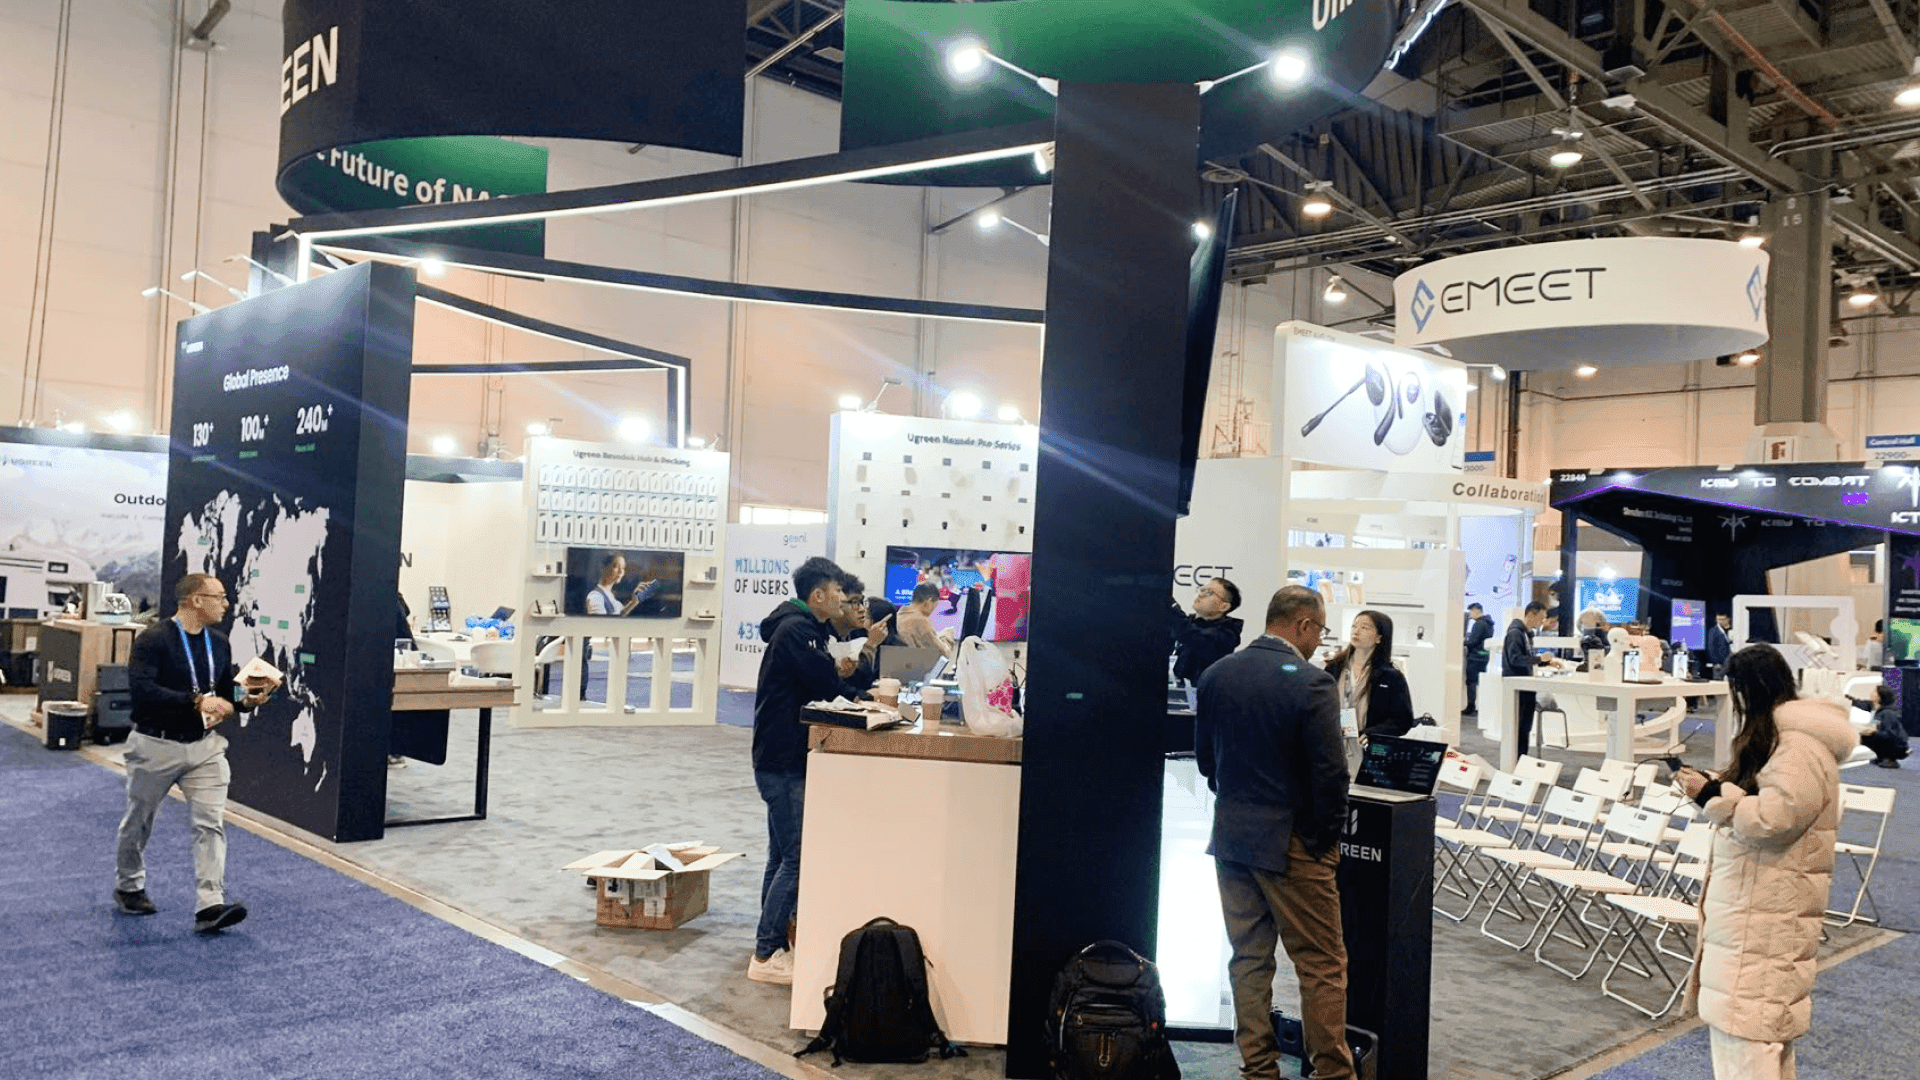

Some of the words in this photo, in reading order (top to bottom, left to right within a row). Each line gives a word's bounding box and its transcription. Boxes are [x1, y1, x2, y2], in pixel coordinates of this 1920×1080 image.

[415, 178, 446, 204] of
[1441, 268, 1606, 314] EMEET
[223, 369, 249, 392] Global
[250, 364, 290, 387] Presence
[907, 433, 940, 445] Ugreen
[994, 440, 1021, 452] Series
[1750, 477, 1776, 487] TO
[735, 558, 790, 574] MILLIONS
[735, 579, 749, 593] OF
[753, 579, 789, 595] USERS
[1340, 842, 1381, 862] REEN
